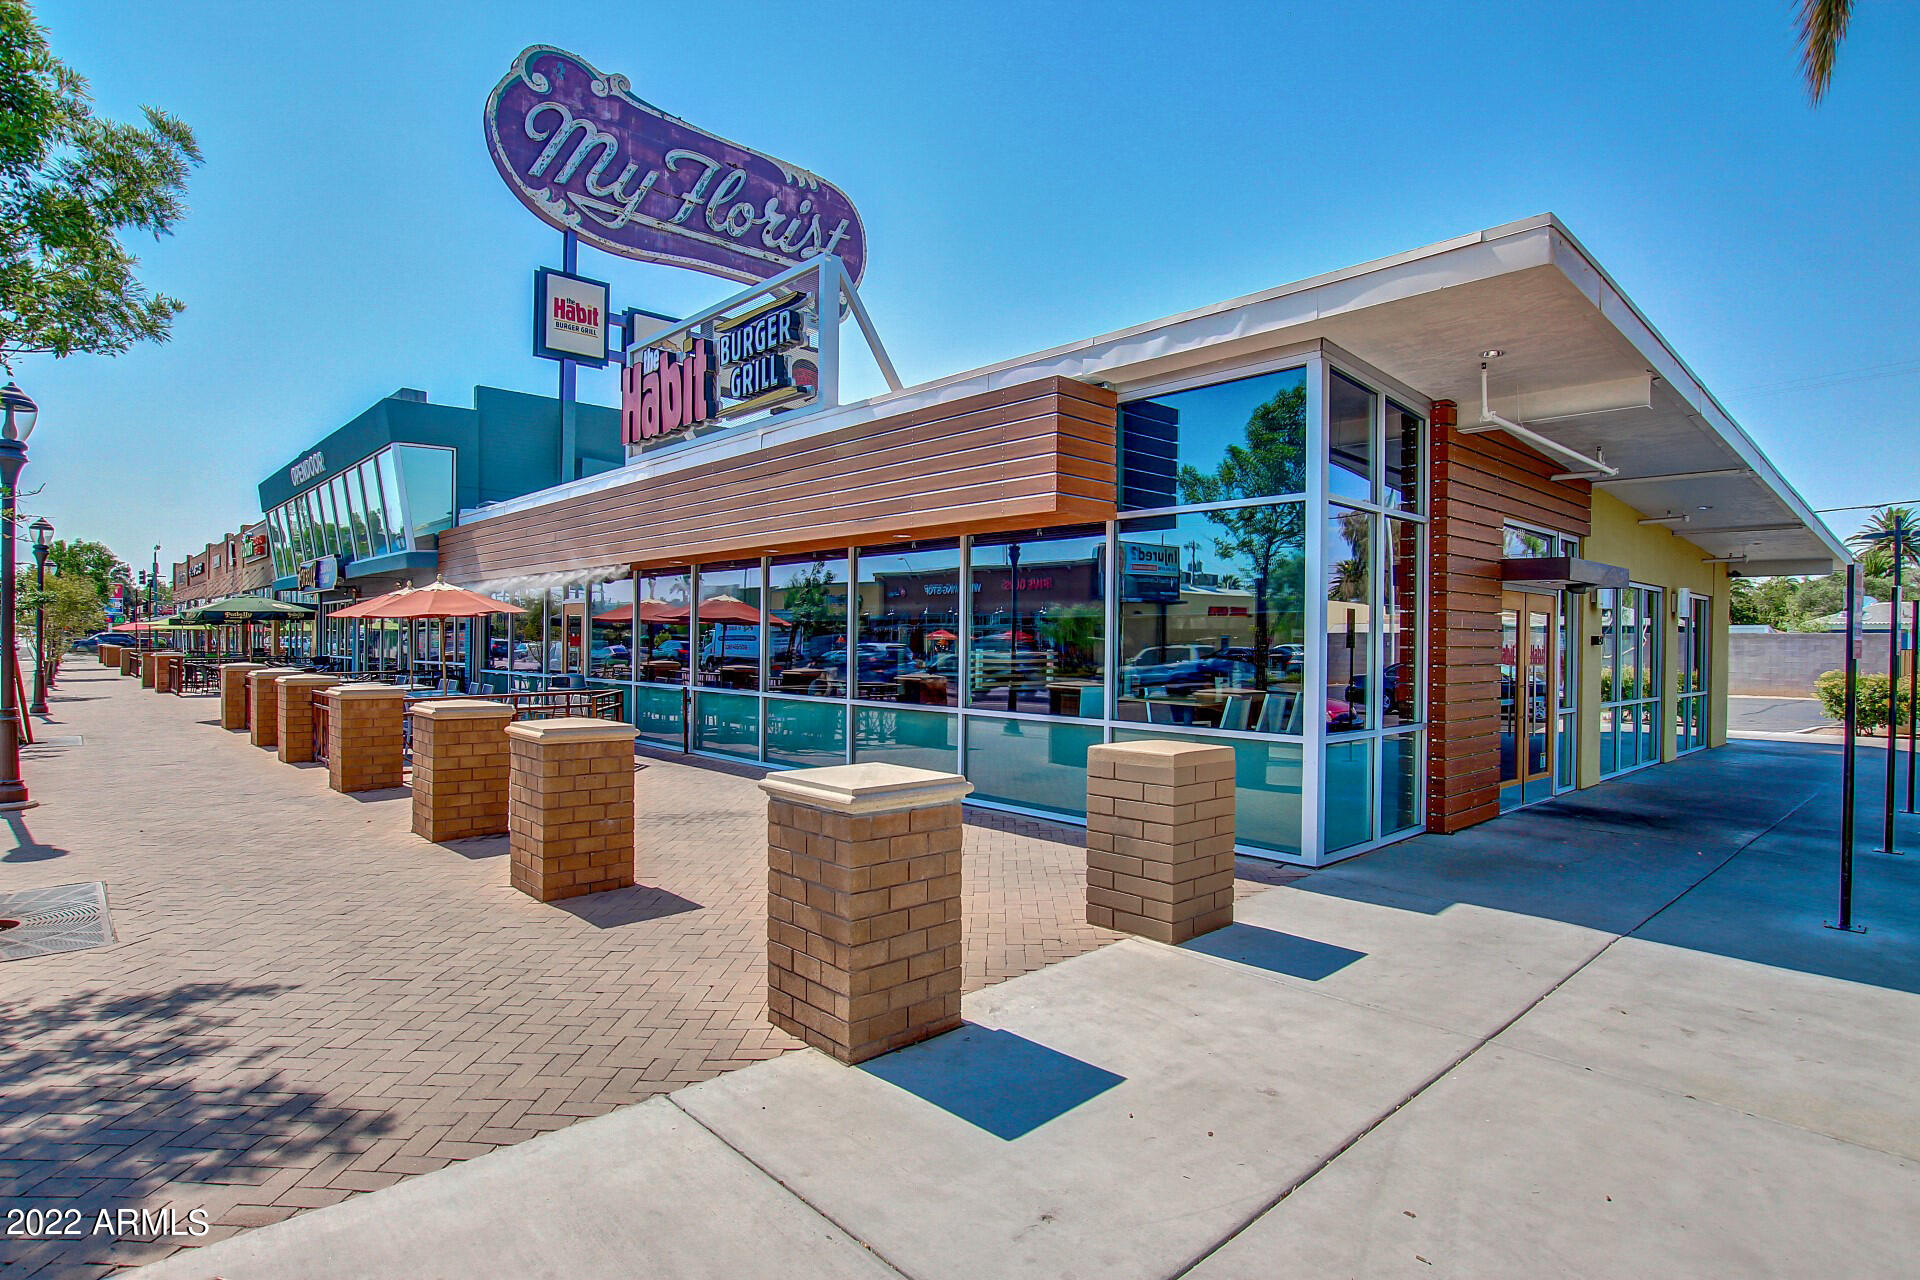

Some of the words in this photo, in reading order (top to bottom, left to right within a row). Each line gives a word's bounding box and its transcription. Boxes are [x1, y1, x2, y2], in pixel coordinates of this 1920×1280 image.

[525, 102, 659, 229] My
[665, 148, 851, 260] Florist
[553, 297, 599, 327] Habit
[555, 321, 580, 332] BURGER
[580, 326, 597, 336] GRILL
[643, 346, 659, 374] the
[719, 309, 792, 367] BURGER
[621, 338, 710, 446] Habit
[730, 355, 779, 399] GRILL
